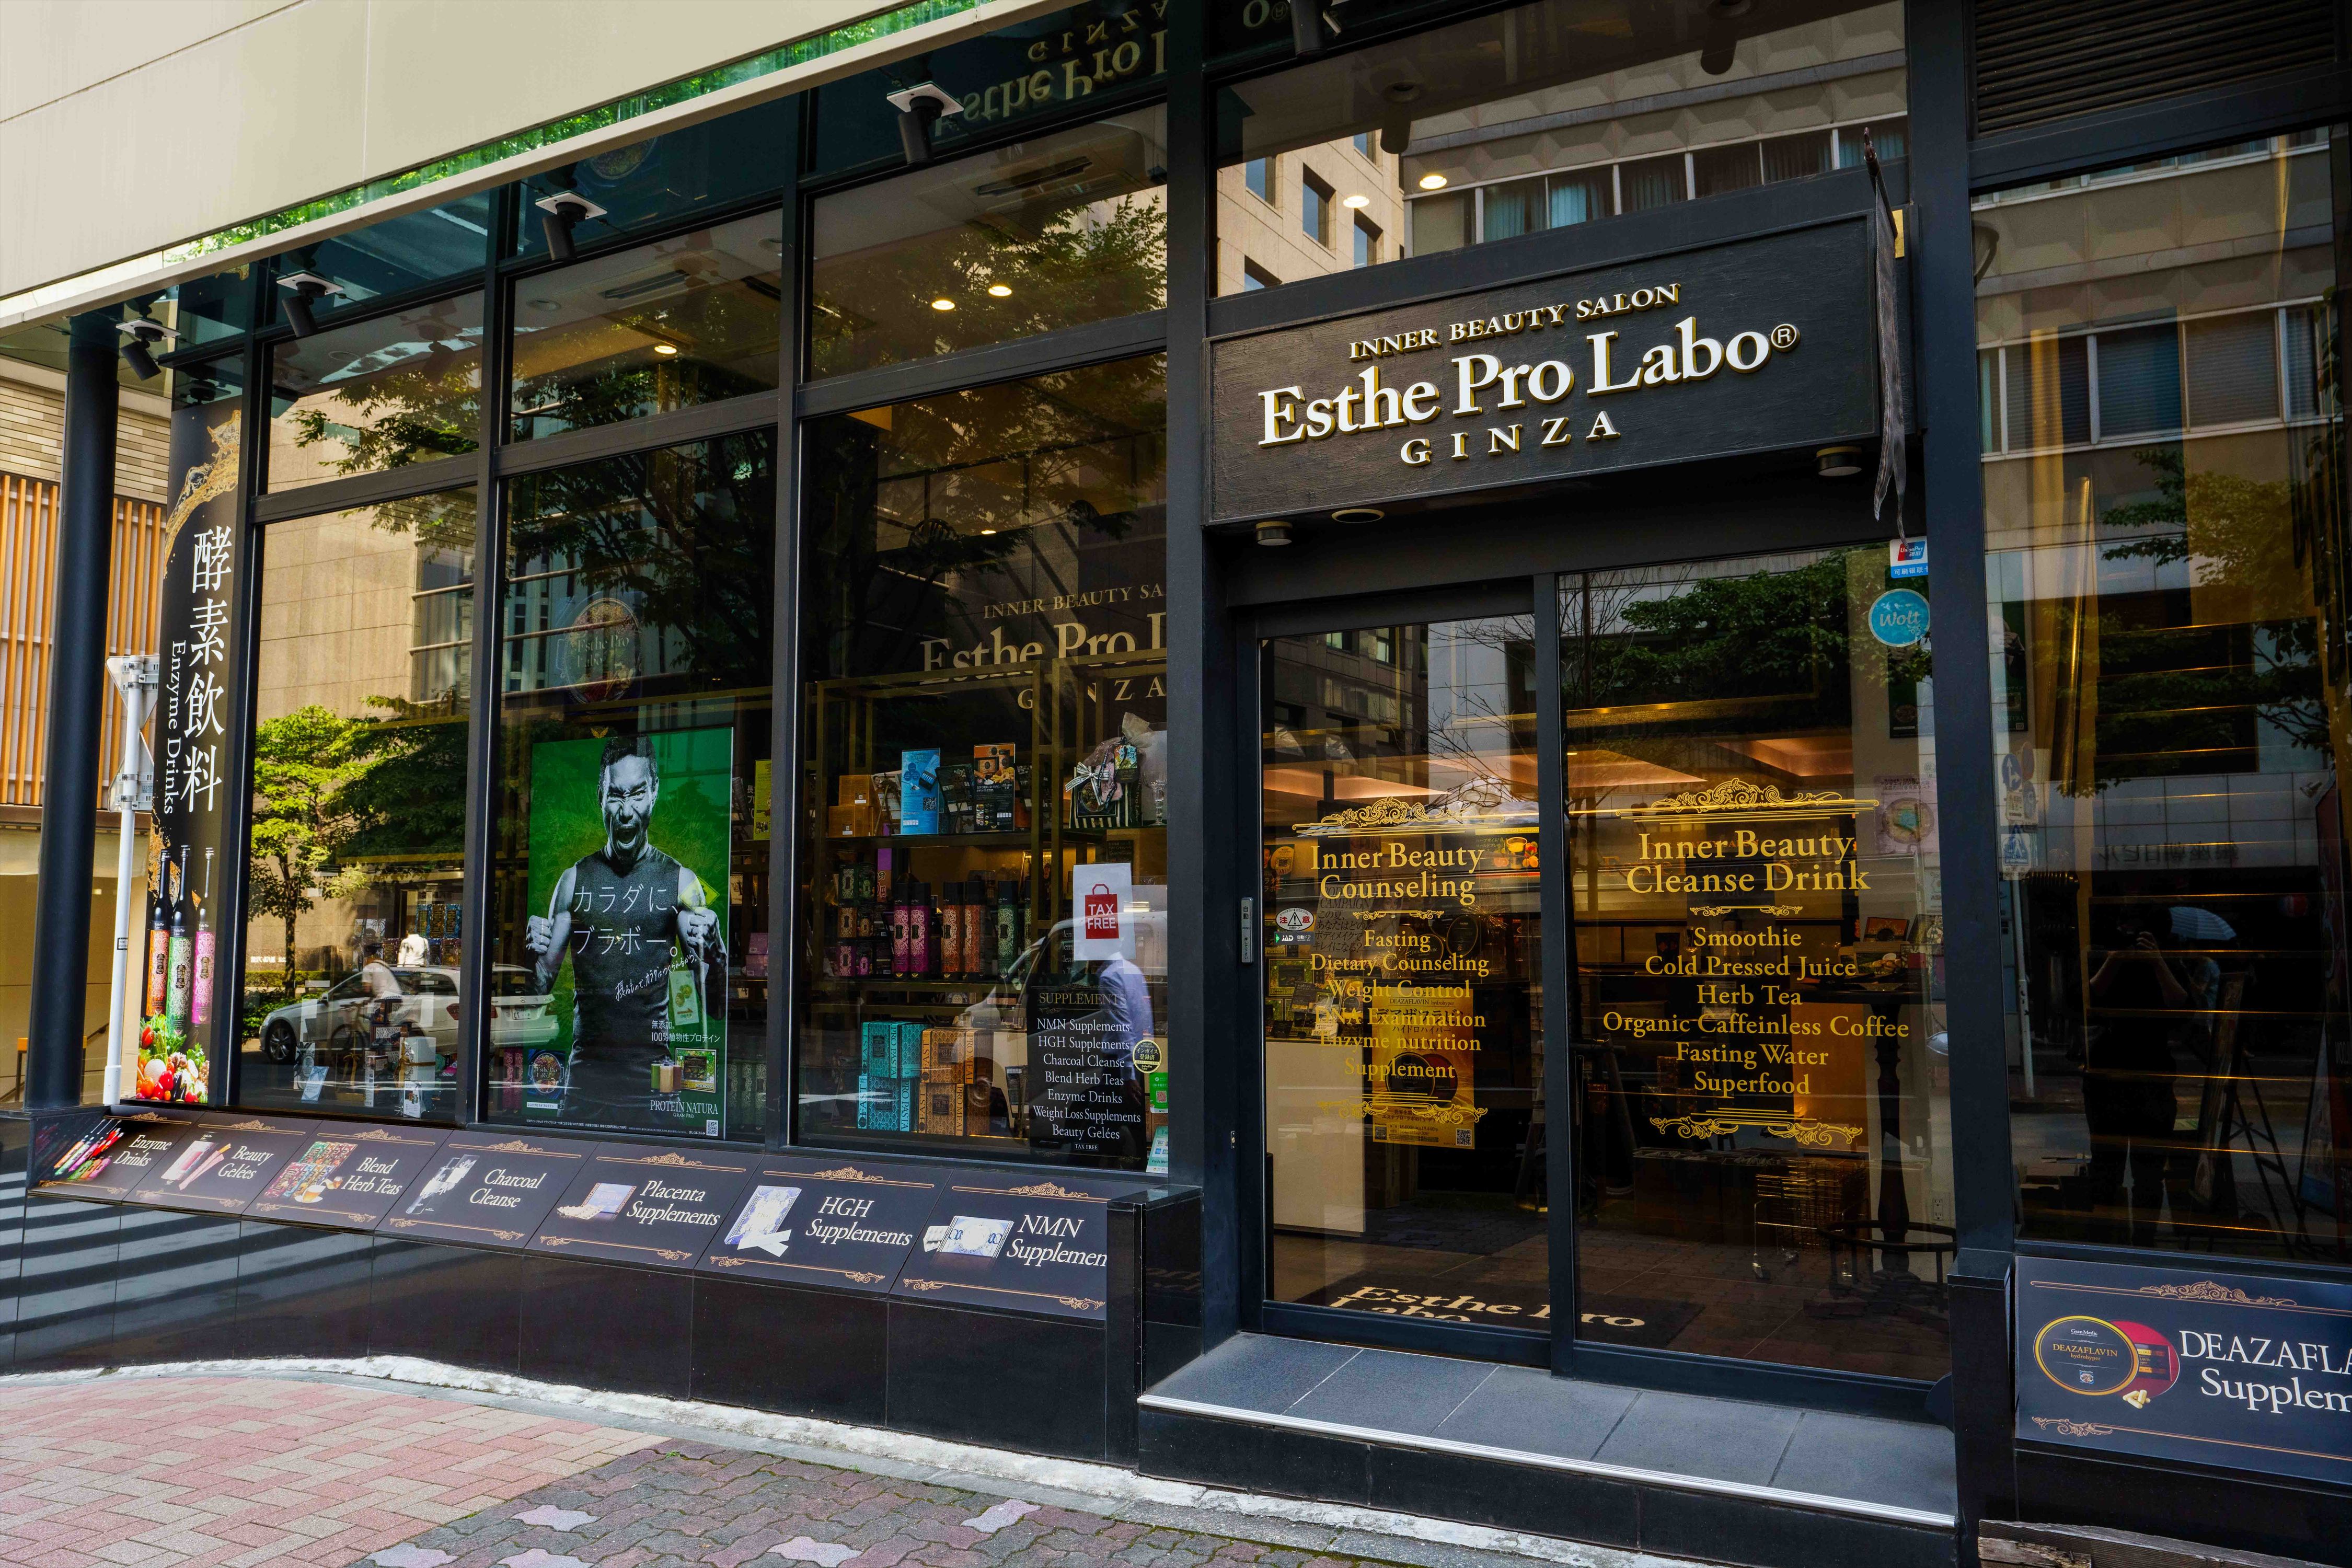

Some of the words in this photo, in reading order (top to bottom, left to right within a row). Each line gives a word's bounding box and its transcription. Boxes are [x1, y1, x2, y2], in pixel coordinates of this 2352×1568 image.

[1350, 327, 1438, 361] INNER
[1449, 303, 1566, 345] BEAUTY
[1576, 282, 1680, 321] SALON
[1258, 366, 1440, 447] Esthe
[1452, 354, 1574, 417] Pro
[1401, 410, 1620, 467] GINZA
[984, 599, 1044, 619] INNER
[1054, 587, 1132, 610] BEAUTY
[1880, 610, 1920, 627] Wolt
[180, 525, 232, 813] 酵素飲料
[166, 640, 186, 730] Enzyme
[164, 737, 182, 815] Drinks
[1310, 845, 1382, 870] Inner
[1389, 843, 1485, 874] Beauty
[1639, 833, 1727, 860] Inner
[1734, 830, 1854, 867] Beauty
[1320, 870, 1475, 905] Counseling
[1627, 860, 1754, 894] Cleanse
[1763, 859, 1871, 891] Drink
[574, 883, 679, 915] カラダに、
[1088, 904, 1114, 915] TAX
[1087, 917, 1116, 929] FREE
[1243, 906, 1249, 919] 自動
[574, 925, 678, 958] ブラボー。
[1364, 930, 1431, 952] Fasting
[1694, 926, 1802, 947] Smoothie
[1310, 953, 1377, 976] Dietary
[1382, 952, 1489, 979] Counseling
[1645, 955, 1698, 976] Cold
[1707, 955, 1790, 976] Pressed
[1797, 956, 1856, 981] Juice
[1039, 993, 1127, 1006] SUPPLEMENTS
[1329, 980, 1391, 1002] Weight
[1397, 979, 1471, 999] Control
[1697, 984, 1754, 1005] Herb
[1761, 985, 1803, 1006] Tea
[1037, 1018, 1066, 1030] NMN
[1069, 1019, 1129, 1034] Supplements
[1315, 1007, 1363, 1025] DNA
[1367, 1008, 1486, 1028] Examination
[1604, 1012, 1690, 1036] Organic
[1698, 1012, 1821, 1035] Caffeinless
[1829, 1016, 1909, 1037] Coffee
[651, 1032, 720, 1043] 100%植物性プロテイン
[1039, 1036, 1066, 1048] HGH
[1069, 1036, 1129, 1052] Supplements
[1320, 1033, 1390, 1053] Enzyme
[1397, 1034, 1482, 1052] nutrition
[1043, 1054, 1084, 1066] Charcoal
[1088, 1055, 1125, 1068] Cleanse
[1676, 1042, 1757, 1070] Fasting
[1761, 1044, 1829, 1066] Water
[1045, 1071, 1072, 1083] Blend
[1076, 1073, 1100, 1085] Herb
[1103, 1074, 1124, 1086] Teas
[1344, 1057, 1455, 1081] Supplement
[1694, 1071, 1811, 1098] Superfood
[650, 1100, 685, 1112] PROTEIN
[686, 1102, 718, 1115] NATURA
[1047, 1089, 1086, 1104] Enzyme
[1089, 1091, 1122, 1104] Drinks
[901, 1101, 909, 1130] PASTA
[1033, 1105, 1063, 1121] Weight
[1065, 1107, 1083, 1120] Loss
[1085, 1109, 1141, 1124] Supplements
[129, 1134, 173, 1152] Enzyme
[1052, 1124, 1085, 1140] Beauty
[1088, 1126, 1120, 1139] Gelées
[113, 1151, 152, 1167] Drinks
[232, 1145, 274, 1165] Beauty
[357, 1157, 396, 1174] Blend
[217, 1162, 258, 1181] Gelées
[484, 1168, 547, 1189] Charcoal
[341, 1175, 374, 1192] Herb
[377, 1178, 403, 1196] Teas
[639, 1180, 706, 1202] Placenta
[469, 1187, 521, 1208] Cleanse
[818, 1196, 874, 1218] HGH
[626, 1201, 721, 1227] Supplements
[805, 1218, 913, 1247] Supplements
[1018, 1214, 1085, 1239] NMN
[1345, 1286, 1523, 1314] Esthe
[2053, 1343, 2118, 1357] DEAZAFLAVIN
[2070, 1353, 2101, 1362] hydrohyper
